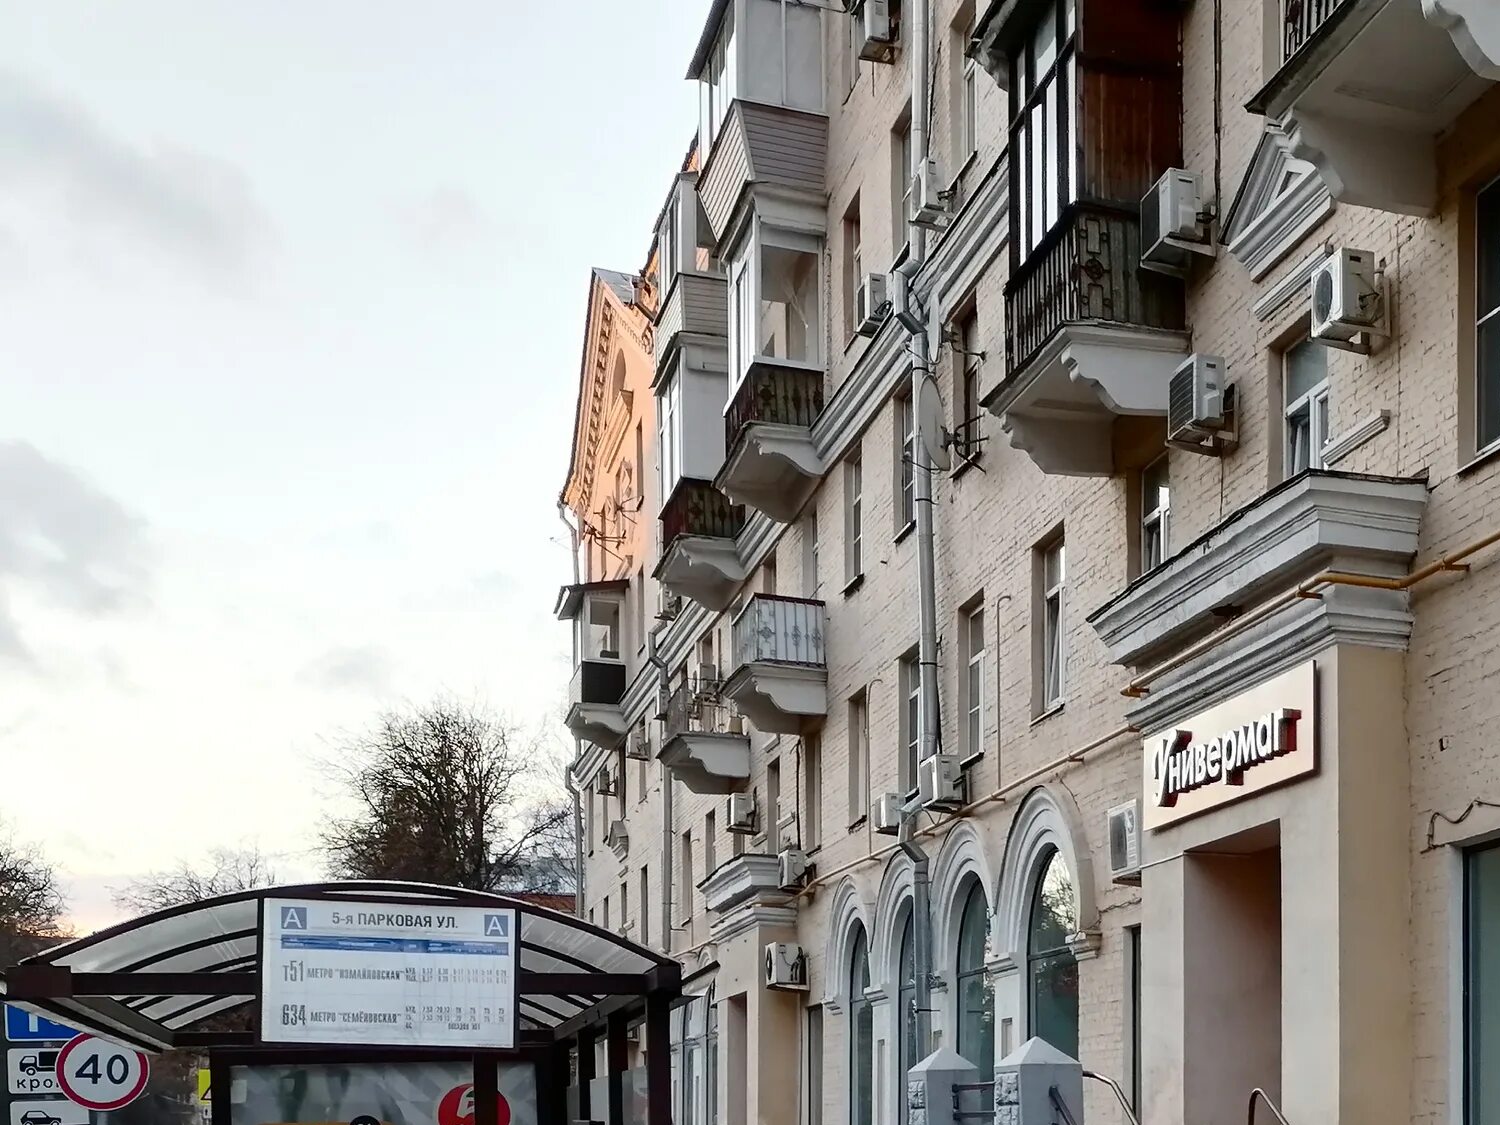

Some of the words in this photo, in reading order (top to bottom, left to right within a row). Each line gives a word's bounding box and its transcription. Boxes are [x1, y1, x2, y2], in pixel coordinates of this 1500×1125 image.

[1151, 708, 1301, 807] Универмаг
[332, 912, 353, 925] 5-я
[358, 913, 432, 928] ПАРКОВАЯ
[437, 916, 458, 929] УЛ.
[307, 968, 333, 979] МЕТРО
[282, 1004, 306, 1026] 634
[310, 1011, 336, 1023] МЕТРО
[75, 1054, 129, 1085] 40
